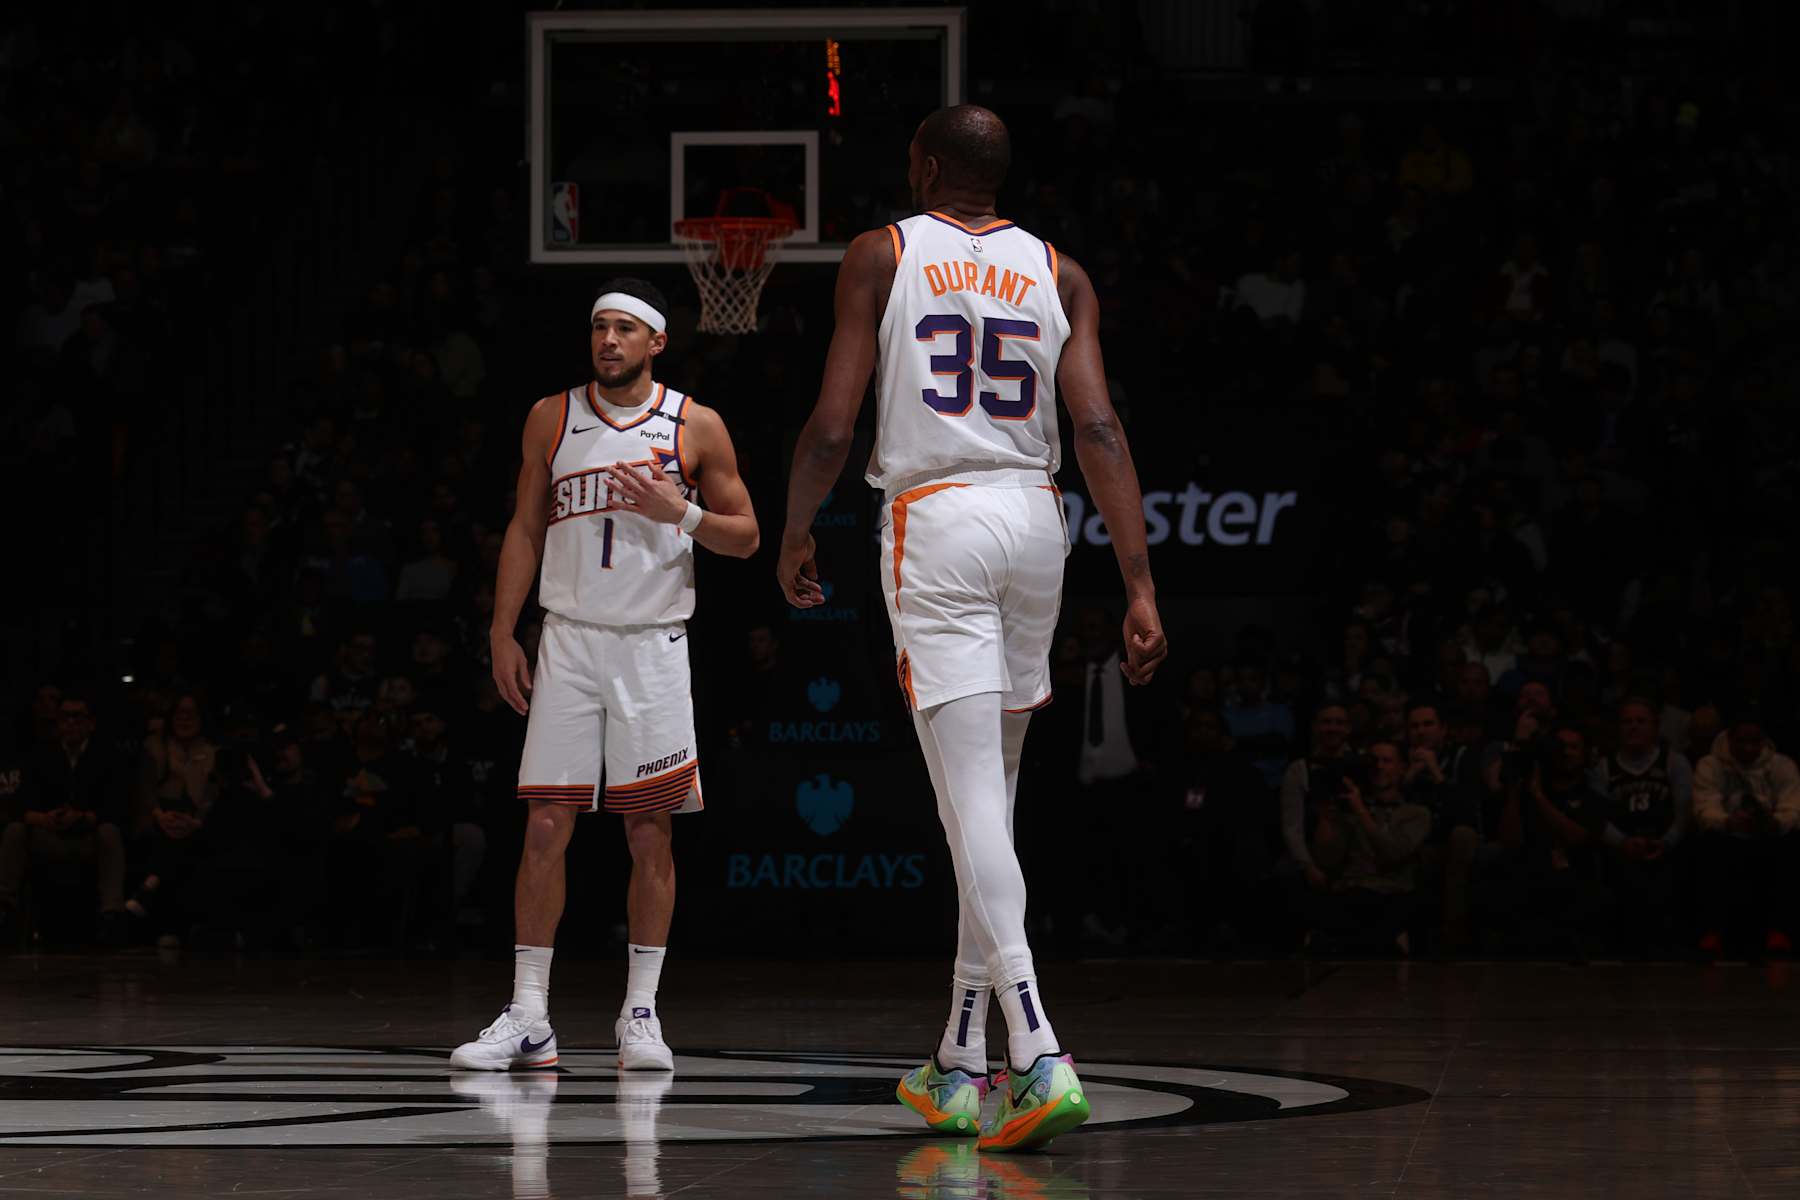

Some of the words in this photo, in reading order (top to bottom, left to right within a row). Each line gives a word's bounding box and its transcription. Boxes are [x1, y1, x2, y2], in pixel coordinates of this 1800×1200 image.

[923, 260, 1037, 307] DURANT
[915, 314, 1041, 421] 35
[640, 430, 670, 441] PayPal
[601, 518, 614, 569] 1
[768, 720, 881, 744] BARCLAYS
[636, 747, 689, 778] PHOENIX
[726, 851, 926, 890] BARCLAYS
